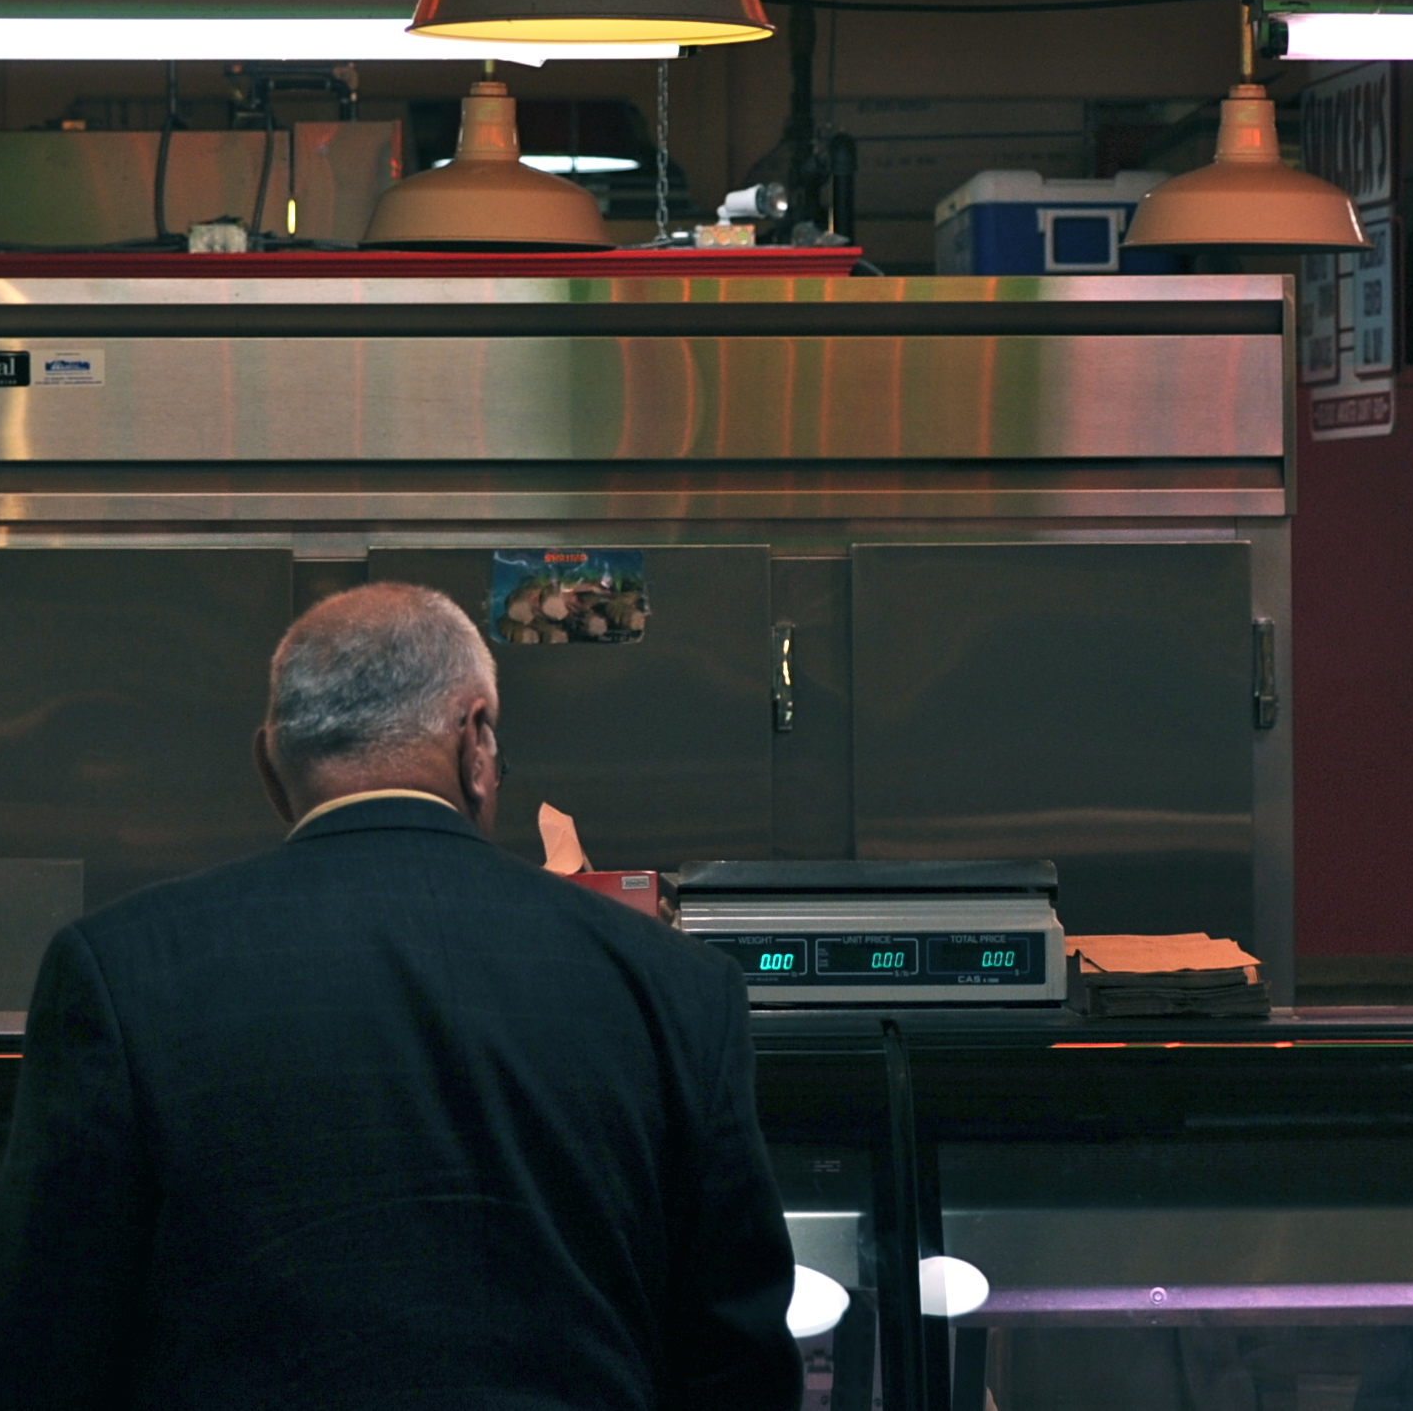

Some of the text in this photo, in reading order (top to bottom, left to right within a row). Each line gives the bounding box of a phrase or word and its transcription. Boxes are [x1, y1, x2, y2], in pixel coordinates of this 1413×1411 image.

[738, 936, 773, 945] WEIGHT
[842, 935, 892, 945] UNIT PRICE
[950, 934, 1006, 944] TOTAL PRICE
[759, 953, 795, 971] 0.00
[871, 951, 905, 969] 0.00
[981, 950, 1016, 968] 0.00
[957, 975, 982, 984] CAS
